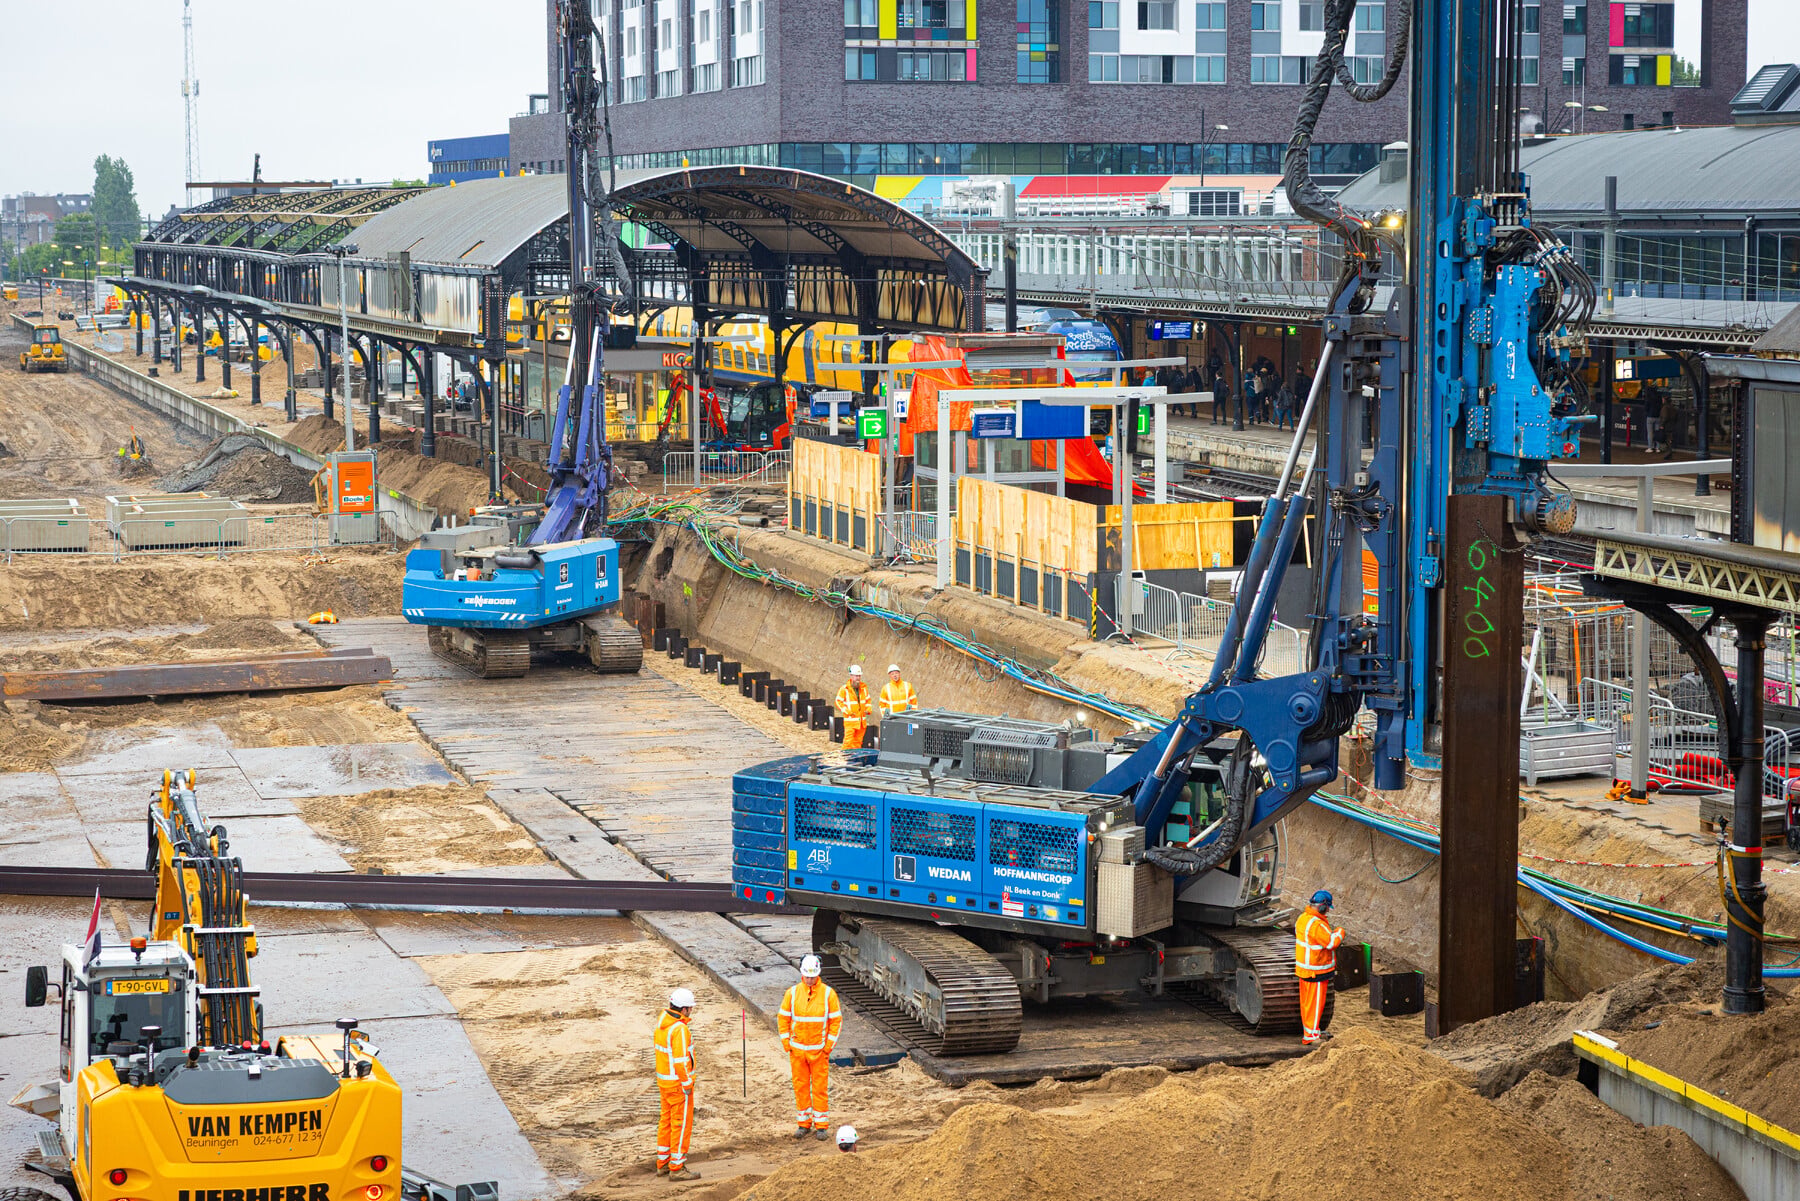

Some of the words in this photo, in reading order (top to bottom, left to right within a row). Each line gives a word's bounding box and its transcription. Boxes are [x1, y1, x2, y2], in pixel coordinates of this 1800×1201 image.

[1464, 540, 1496, 658] 6400
[928, 866, 972, 881] WEDAM
[993, 866, 1073, 885] HOFFMANNGROEP
[1003, 885, 1014, 893] NL
[1014, 886, 1031, 895] Beek
[1042, 890, 1061, 899] Donk
[116, 982, 165, 992] T-90-GVL
[188, 1116, 230, 1137] VAN
[239, 1109, 322, 1136] KEMPEN
[186, 1137, 239, 1149] Beuningen
[253, 1133, 294, 1146] 024-677
[178, 1183, 330, 1201] LIEBHERR
